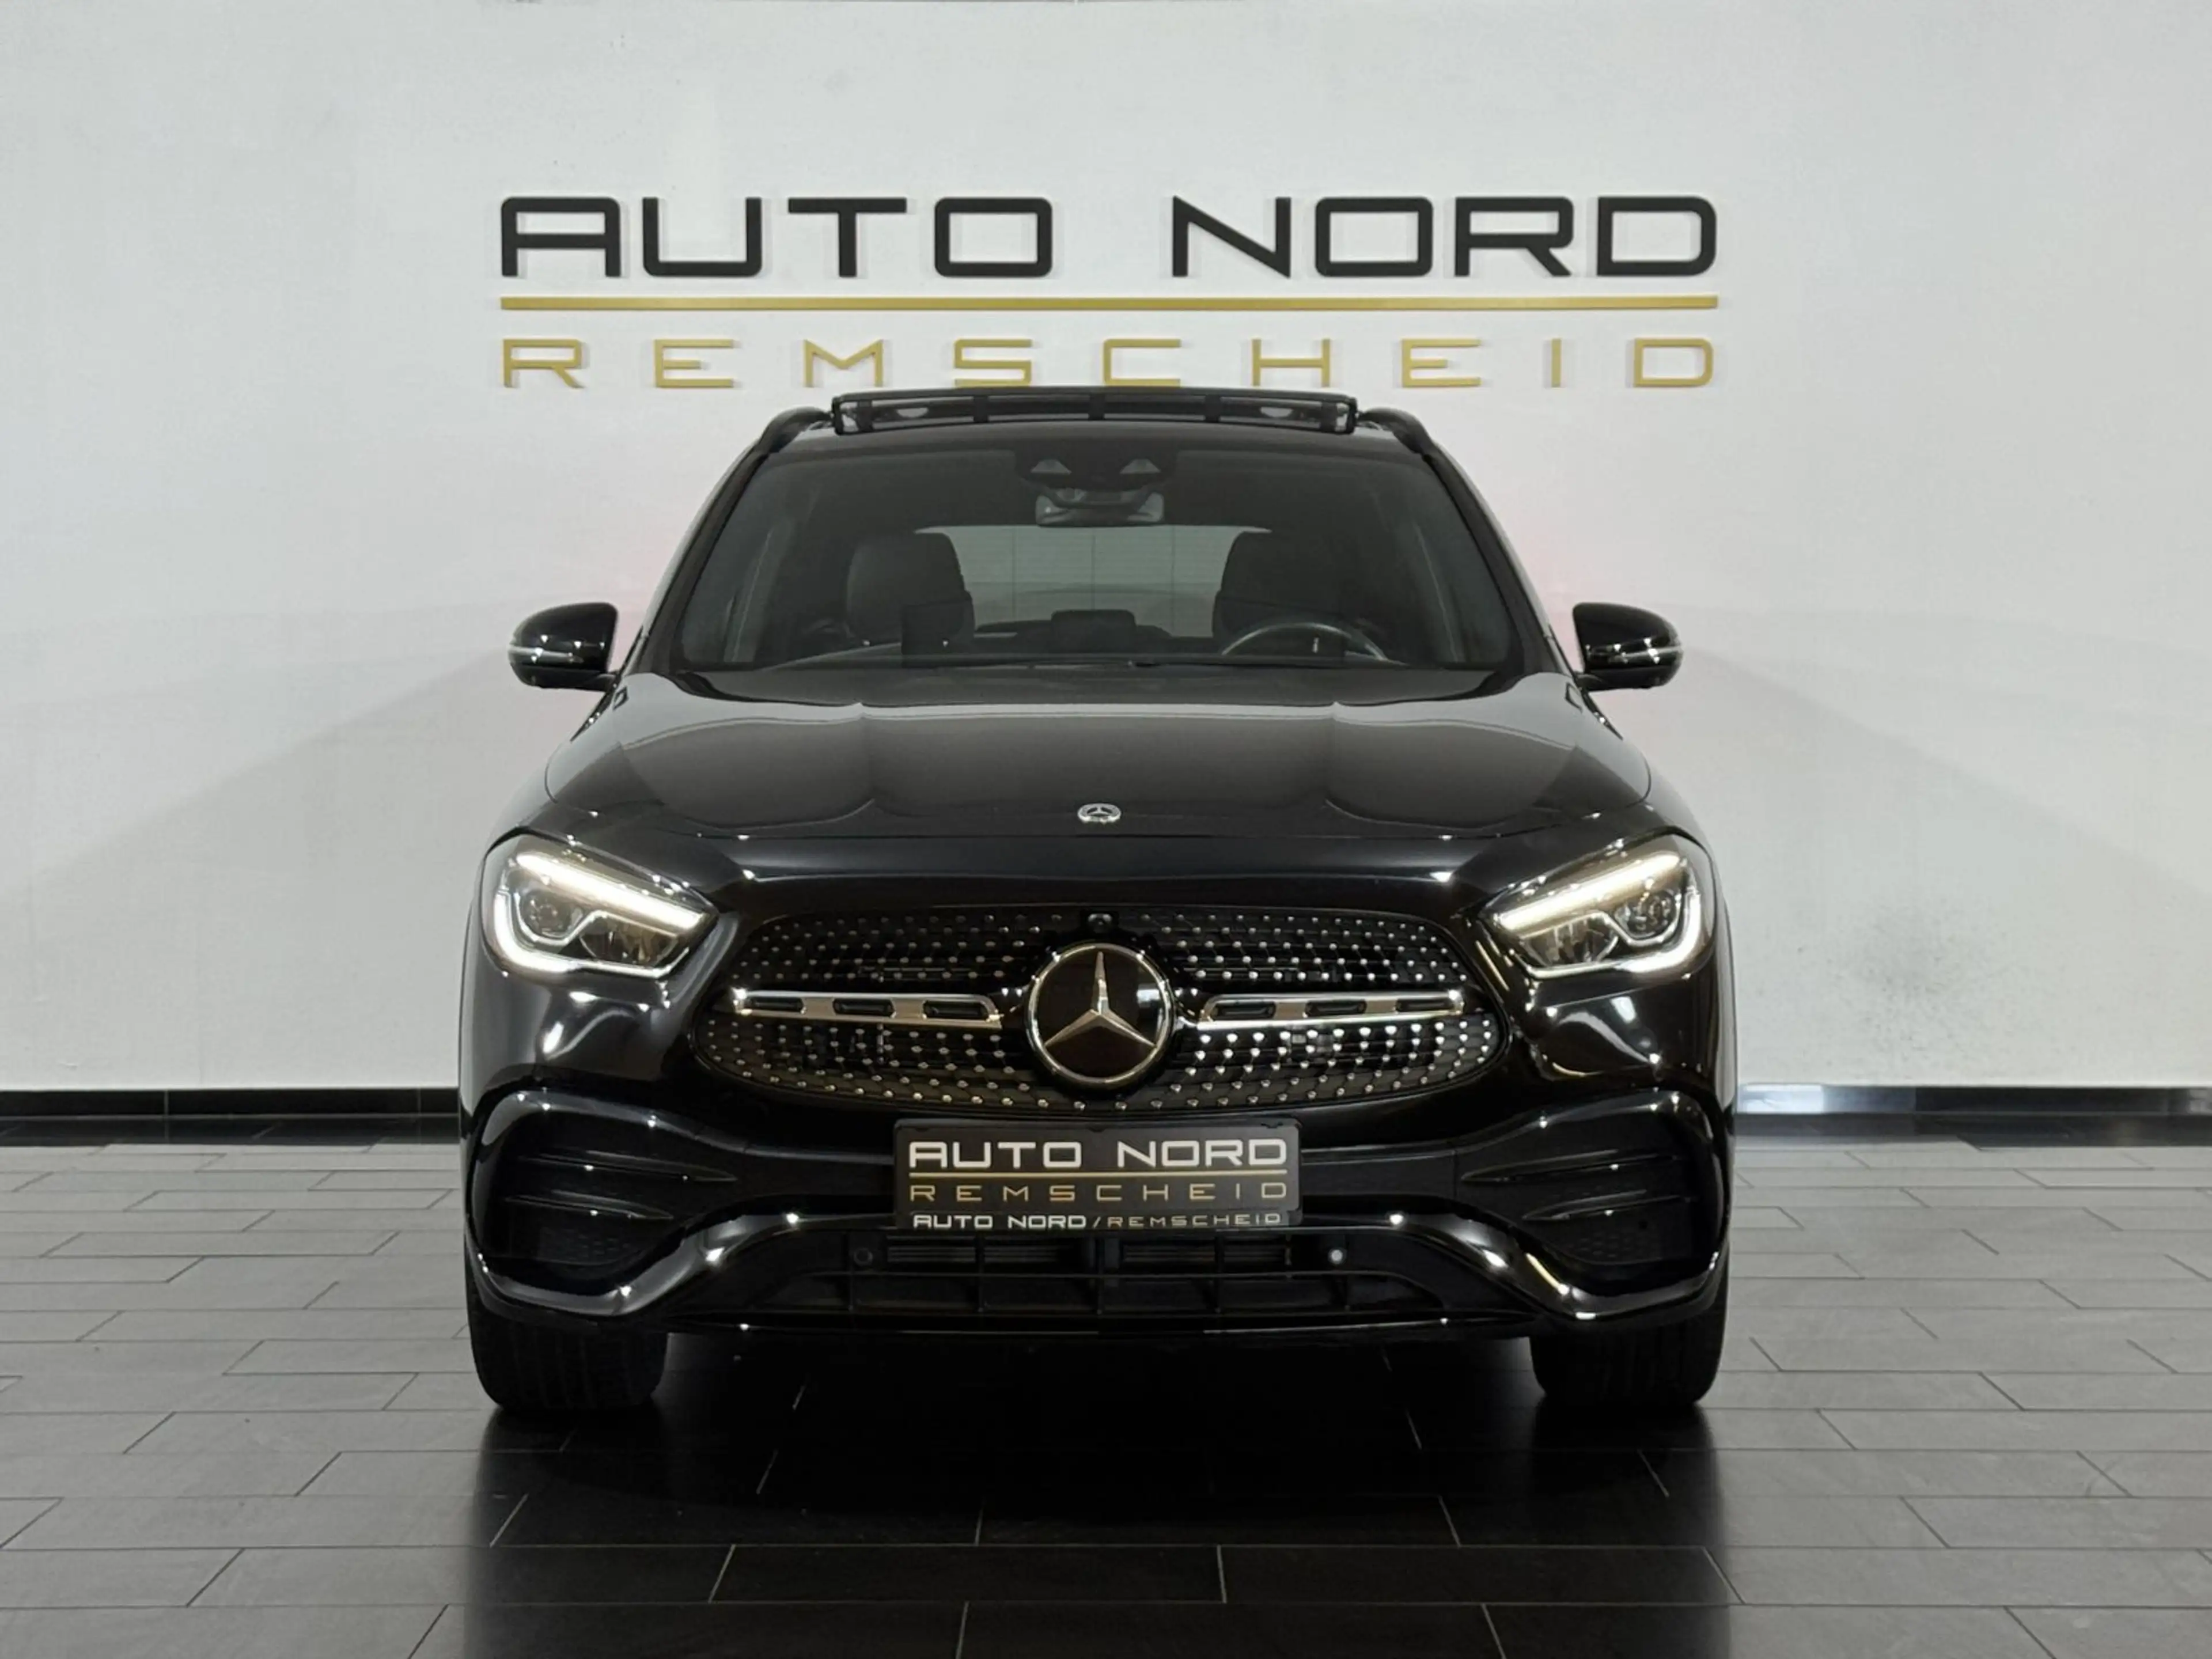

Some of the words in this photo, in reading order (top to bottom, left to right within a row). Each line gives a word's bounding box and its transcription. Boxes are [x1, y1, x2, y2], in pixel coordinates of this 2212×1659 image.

[501, 196, 1053, 278] AUTO
[1172, 195, 1717, 278] NORD
[502, 339, 1714, 388] REMSCHEID
[909, 1141, 1082, 1169] AUTO
[1117, 1138, 1287, 1168] NORD
[910, 1183, 1287, 1202] REMSCHEID
[913, 1214, 994, 1229] AUTO
